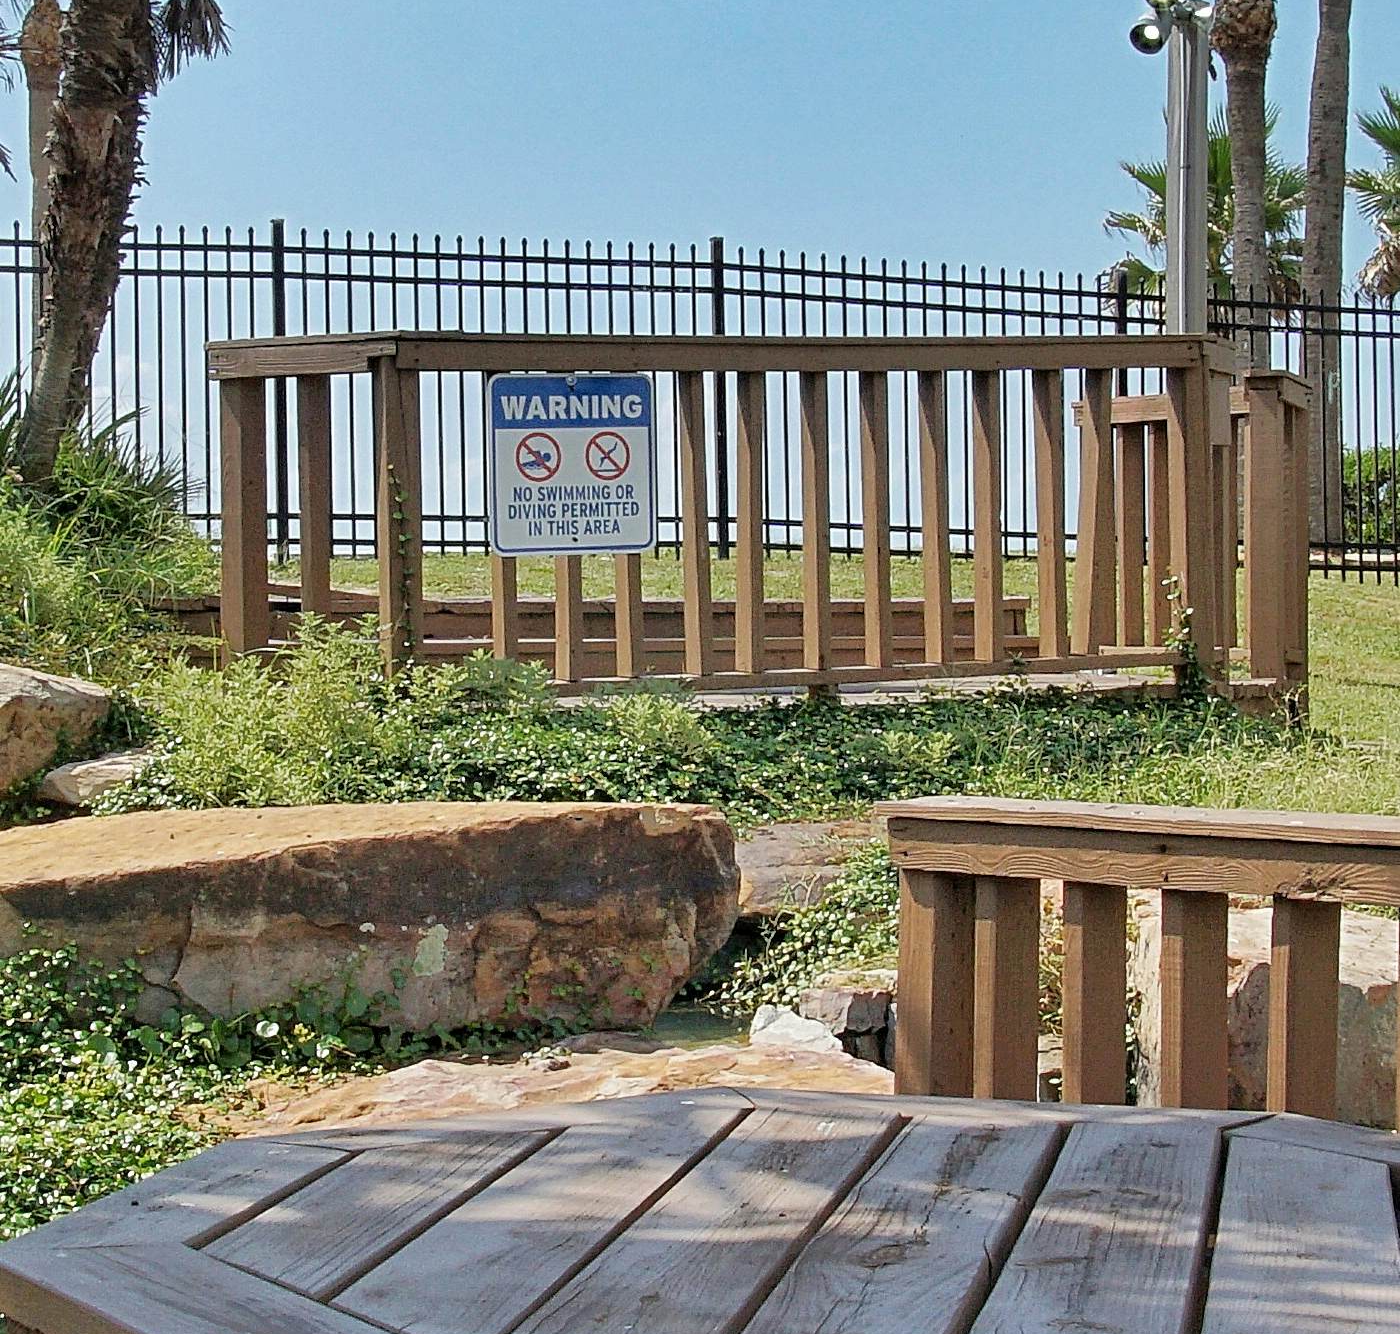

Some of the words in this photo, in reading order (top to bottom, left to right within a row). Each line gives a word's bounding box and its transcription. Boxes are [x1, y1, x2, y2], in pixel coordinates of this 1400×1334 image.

[501, 394, 643, 420] WARNING
[513, 486, 533, 502] NO
[537, 485, 611, 501] SWIMMING
[615, 484, 634, 500] OR
[508, 503, 557, 519] DIVING
[561, 501, 640, 518] PERMITTED
[528, 520, 543, 536] IN
[547, 520, 579, 536] THIS
[583, 519, 621, 535] AREA
